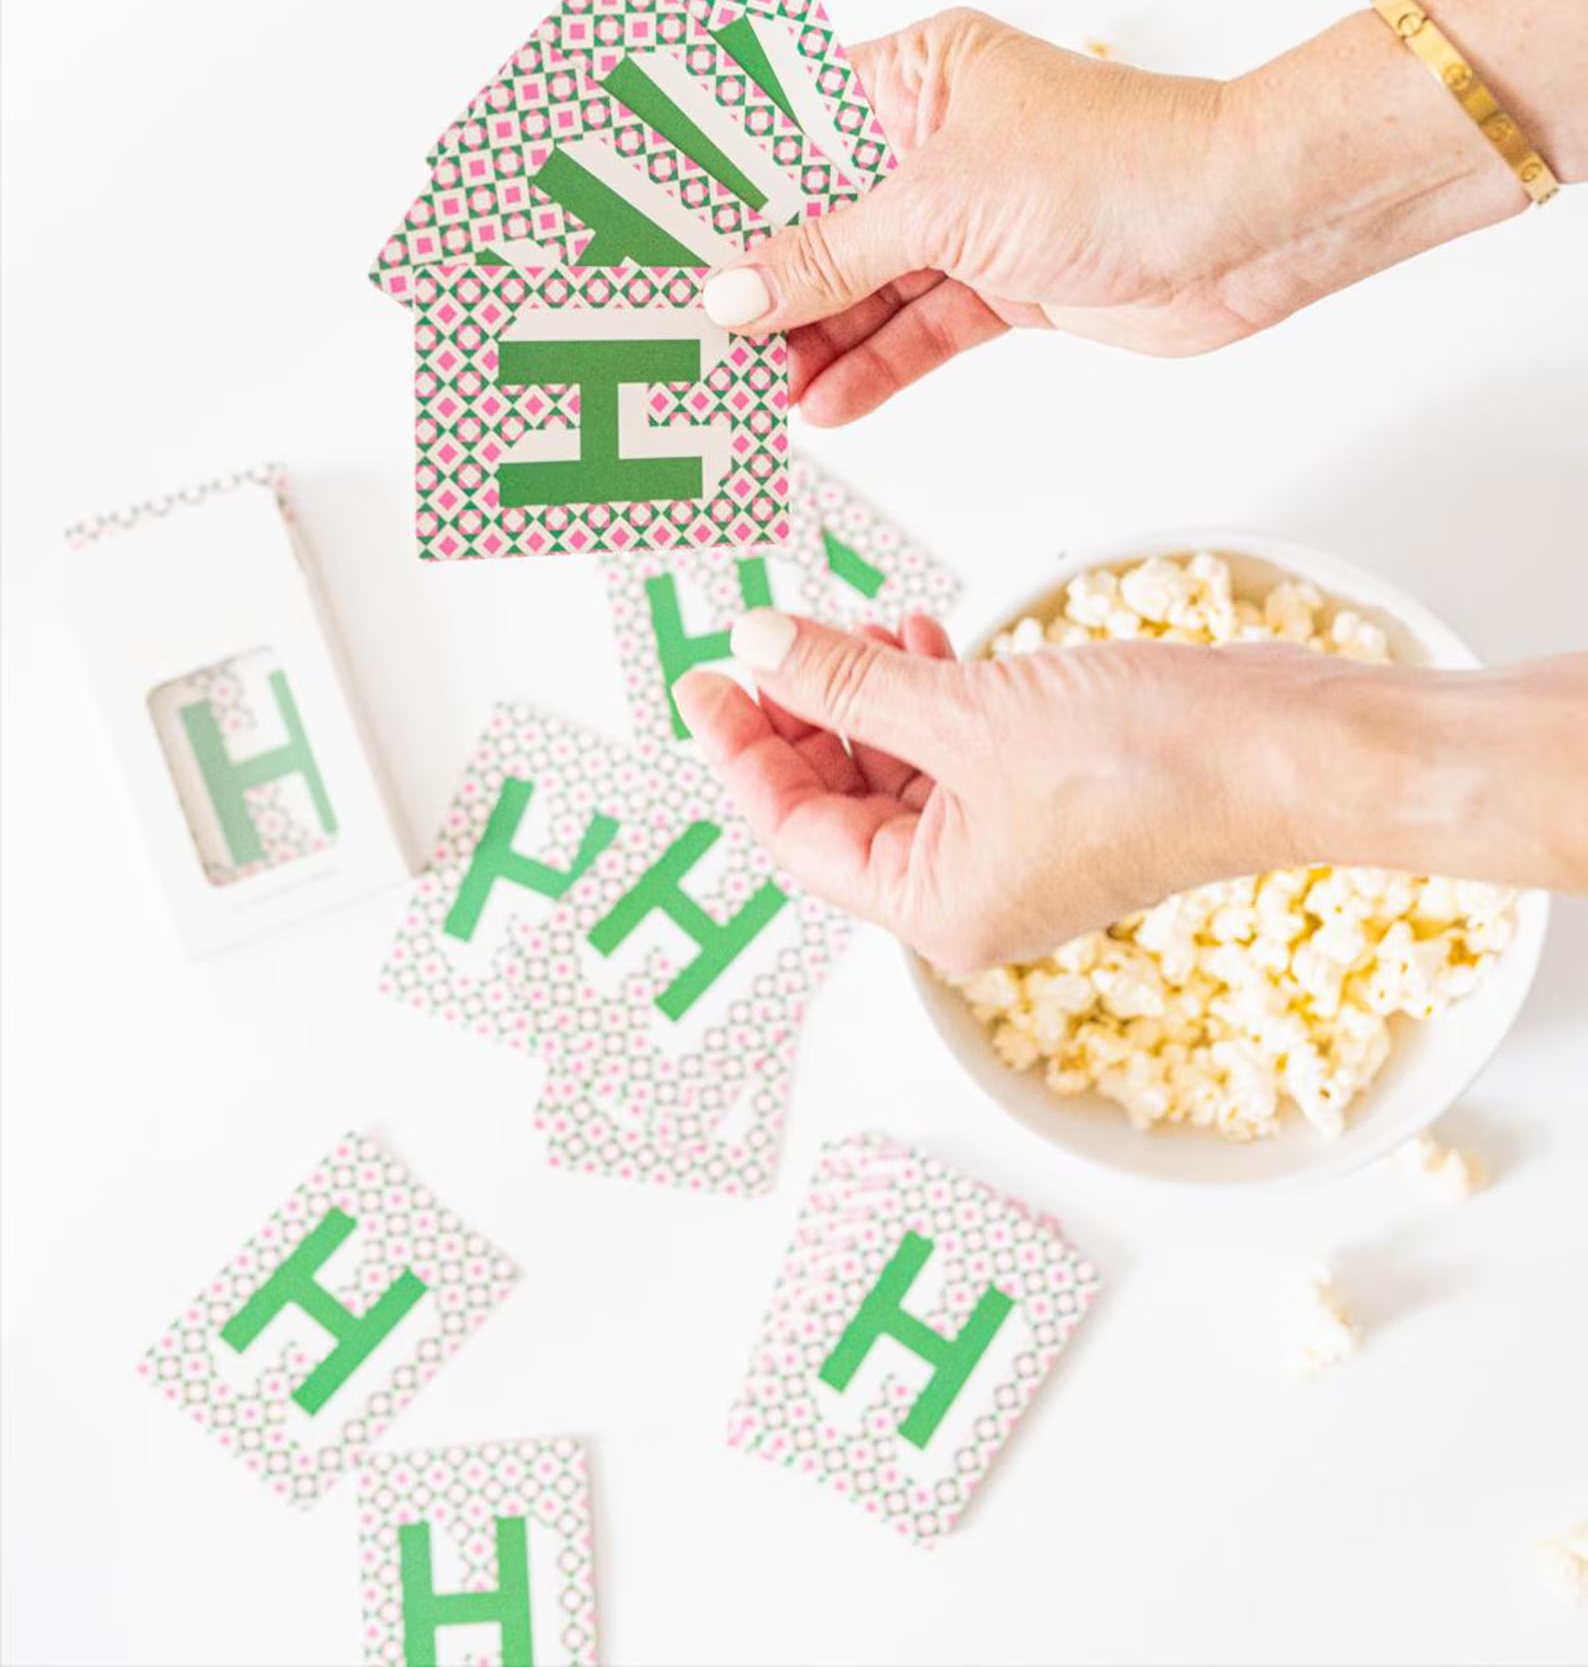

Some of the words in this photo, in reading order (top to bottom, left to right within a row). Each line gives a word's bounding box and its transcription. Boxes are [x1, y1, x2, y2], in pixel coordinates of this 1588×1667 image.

[498, 338, 703, 508] H
[179, 668, 340, 866] H
[585, 817, 791, 1023] H
[218, 1205, 430, 1418] H
[816, 1229, 1018, 1451] H
